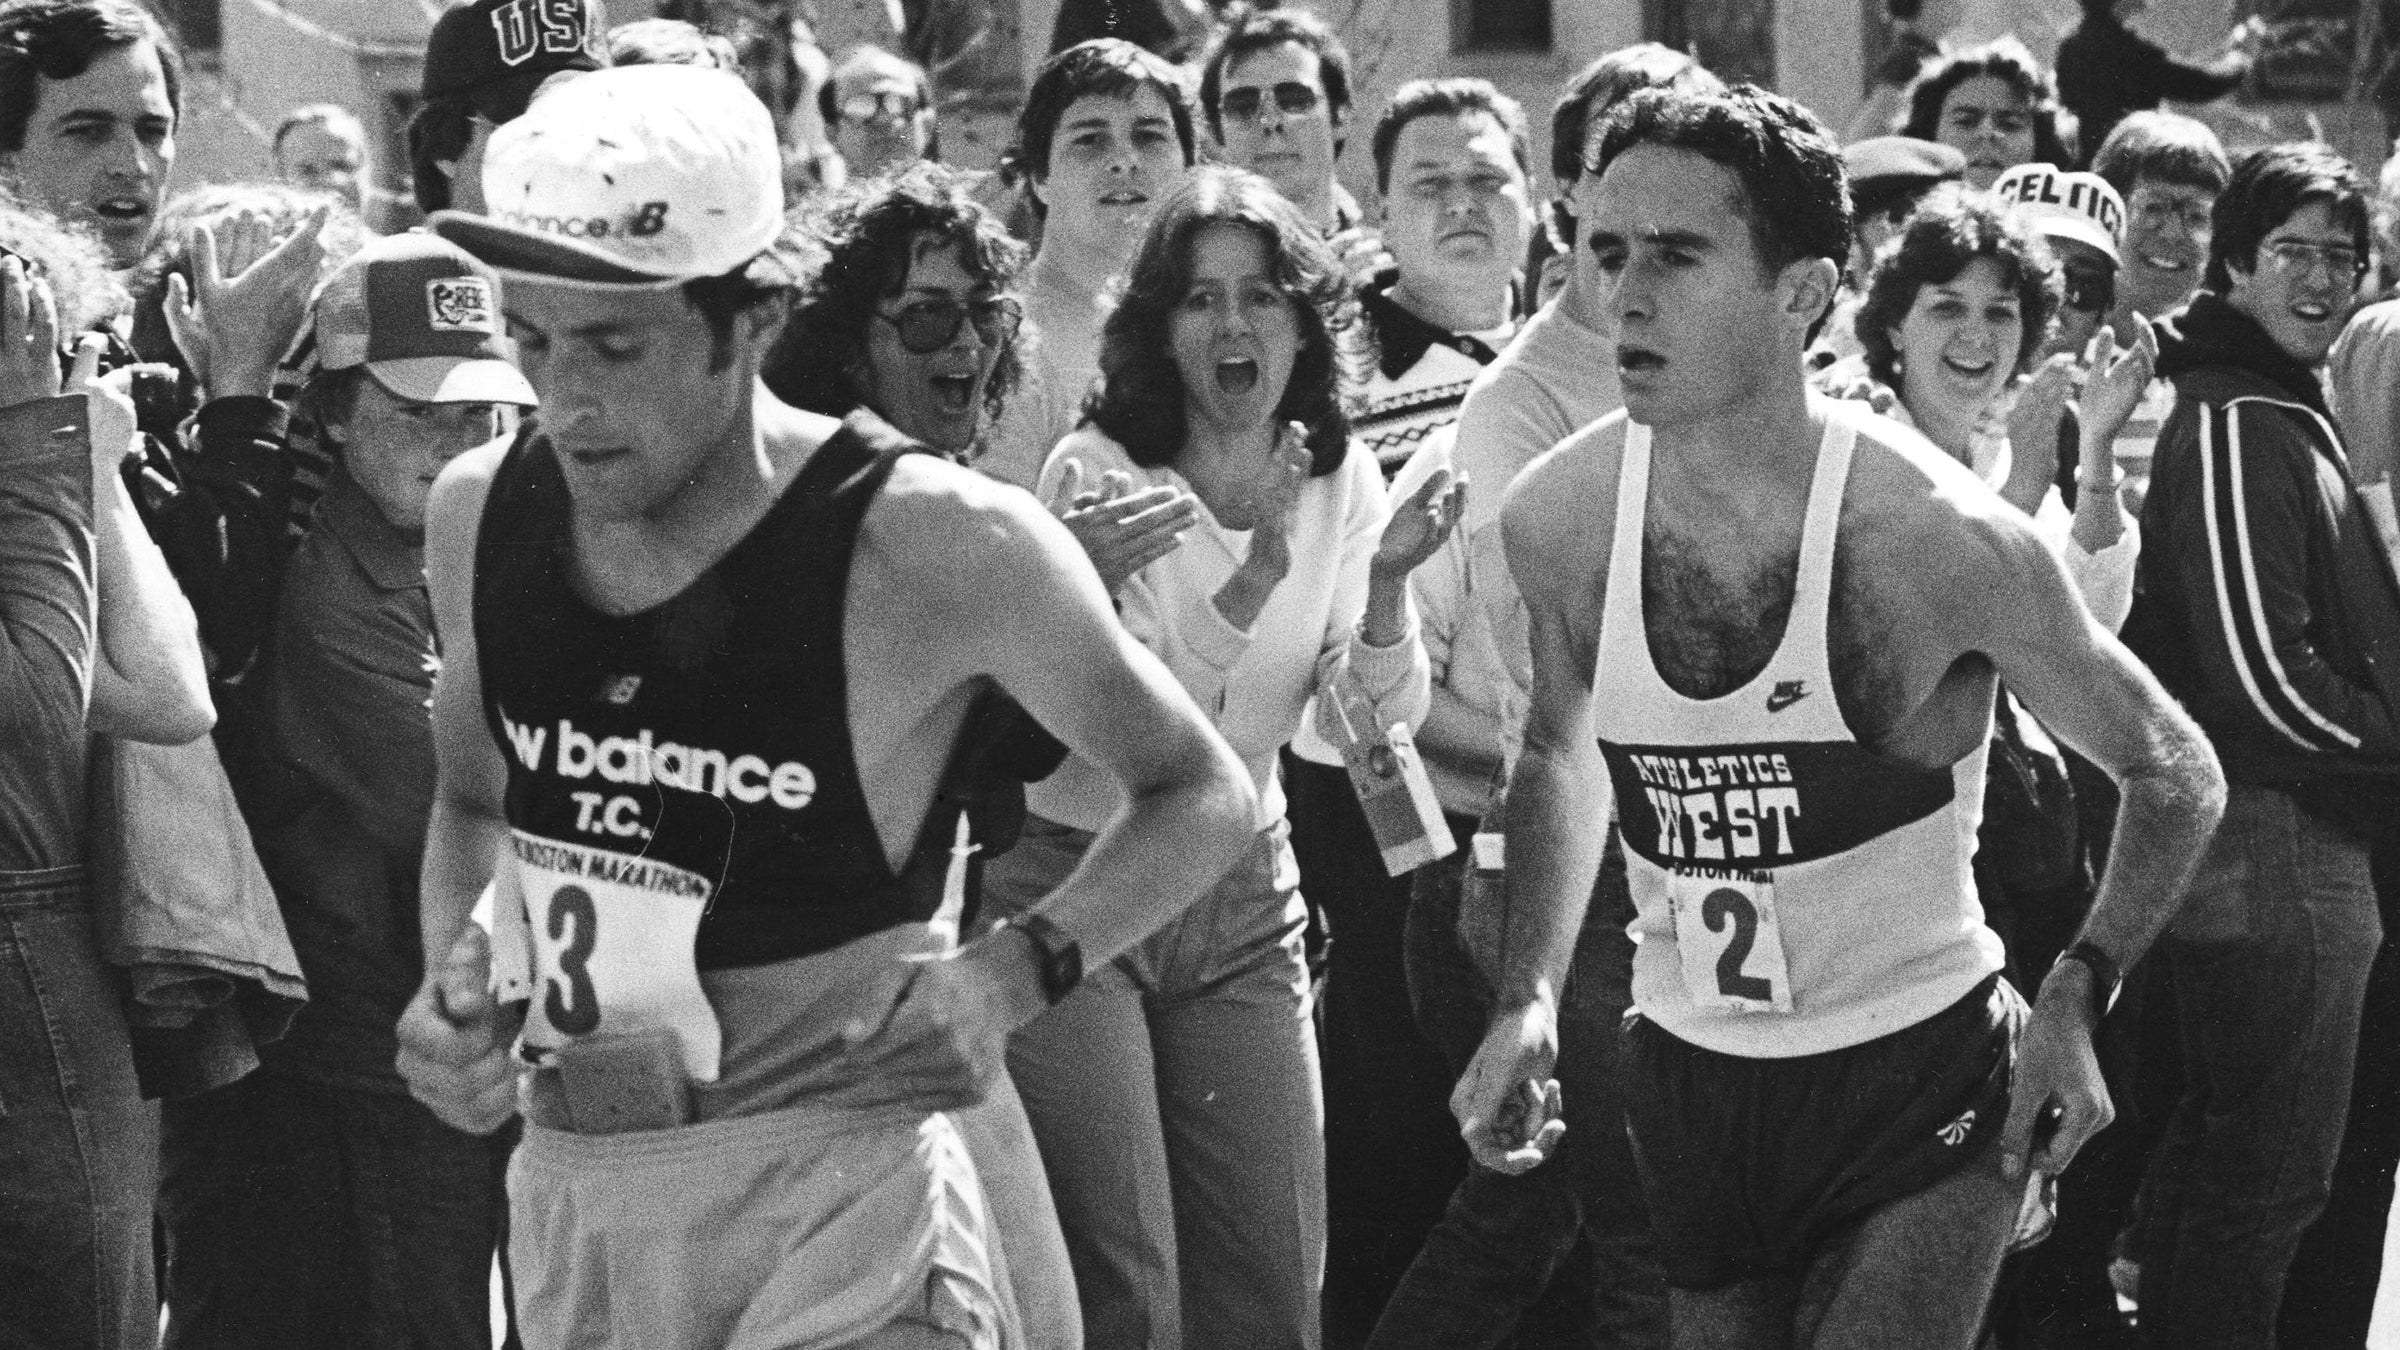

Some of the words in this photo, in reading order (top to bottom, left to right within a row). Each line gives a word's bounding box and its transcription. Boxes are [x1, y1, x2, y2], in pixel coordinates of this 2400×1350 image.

[556, 718, 817, 810] balance
[1629, 753, 1793, 790] ATHLETICS
[570, 791, 651, 840] T.C.
[1645, 786, 1801, 860] WEST
[590, 855, 706, 900] MARATHON
[544, 883, 601, 1037] 3
[1701, 886, 1772, 1002] 2
